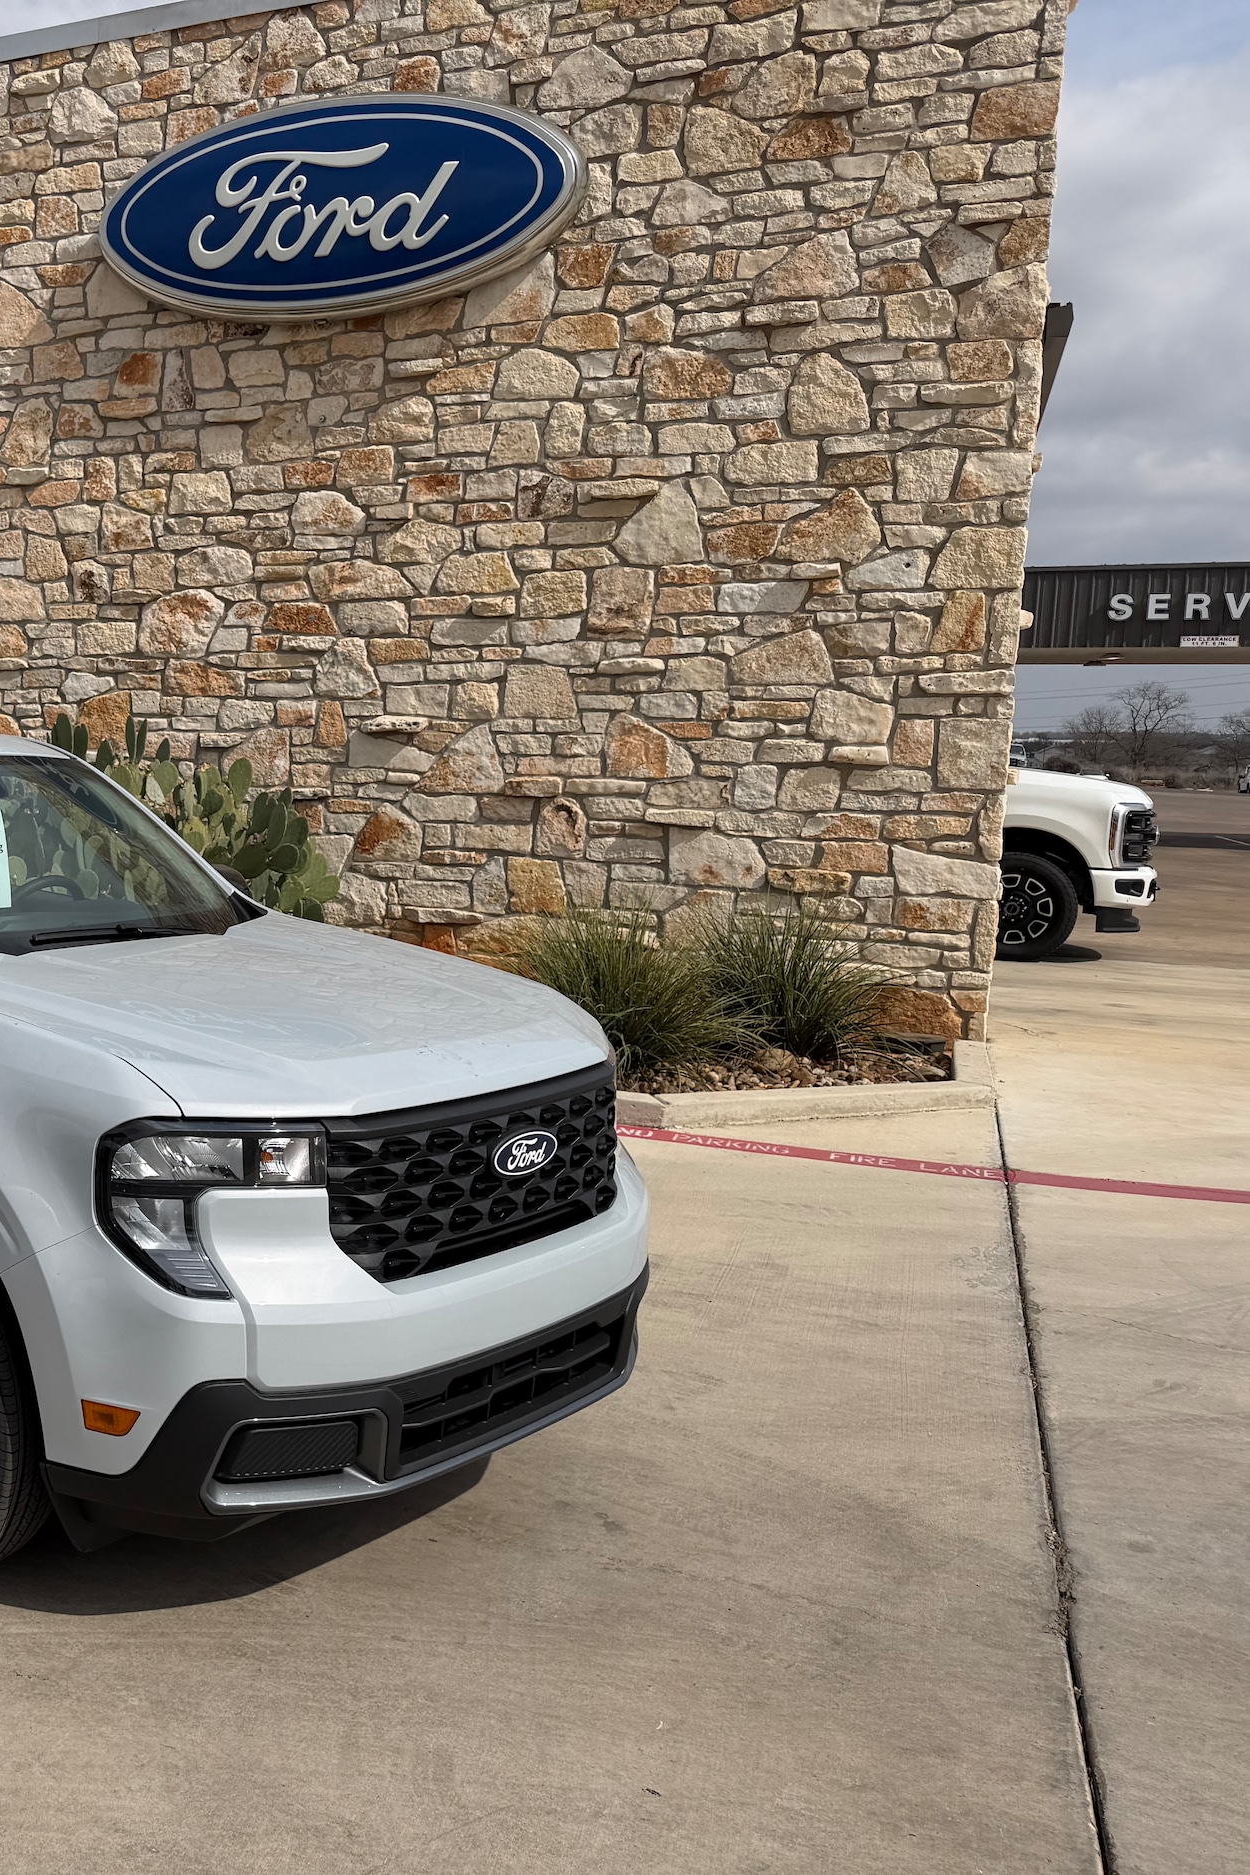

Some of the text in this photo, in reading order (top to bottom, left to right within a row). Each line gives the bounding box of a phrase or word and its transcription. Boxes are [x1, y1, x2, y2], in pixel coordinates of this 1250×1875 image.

[188, 142, 459, 270] Ford
[1107, 592, 1250, 621] SERV
[507, 1137, 547, 1170] Ford
[672, 1133, 790, 1155] PARKING
[829, 1152, 896, 1168] FIRE
[919, 1162, 1001, 1178] LANE
